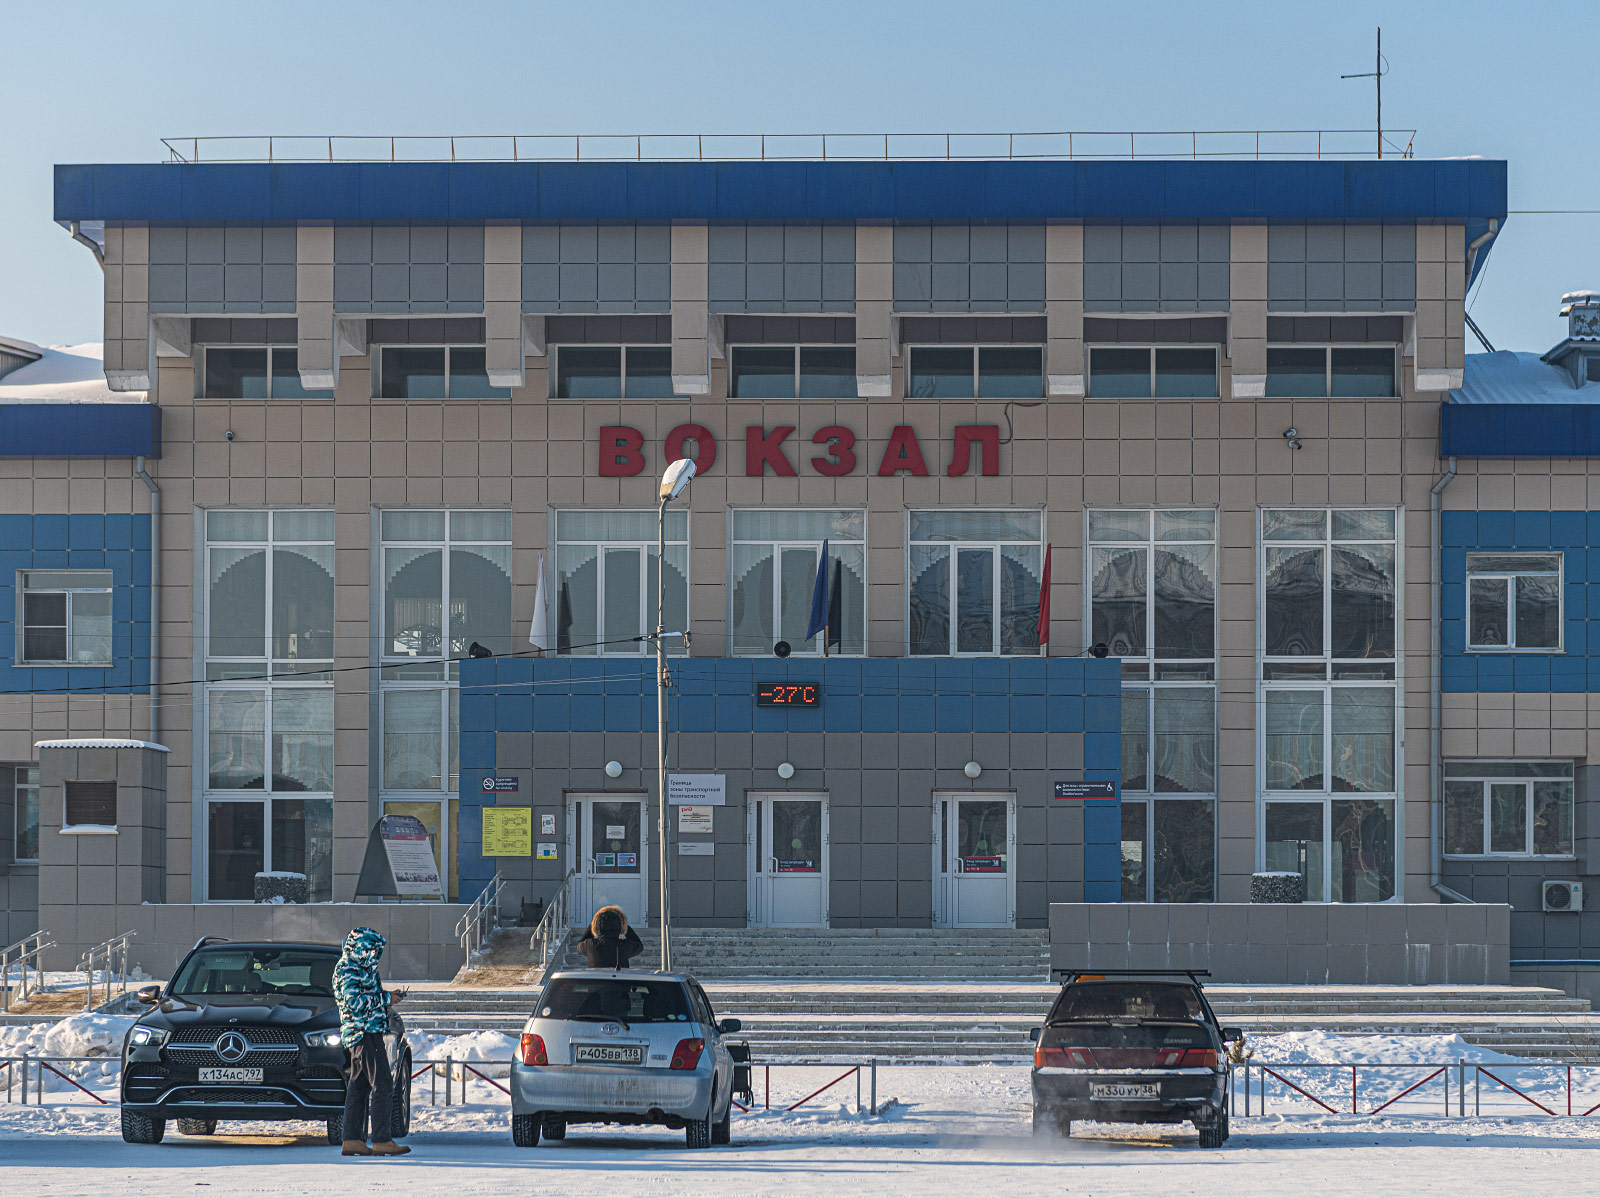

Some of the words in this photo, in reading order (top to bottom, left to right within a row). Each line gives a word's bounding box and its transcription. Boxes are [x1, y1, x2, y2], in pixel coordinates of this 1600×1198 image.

[598, 423, 1000, 477] ВОКЗАЛ
[580, 1048, 621, 1060] Р405ВВ
[623, 1048, 639, 1058] 138
[202, 1069, 243, 1080] Х134АС
[244, 1069, 261, 1078] 797
[1096, 1085, 1140, 1096] М330УУ
[1142, 1085, 1154, 1094] 38
